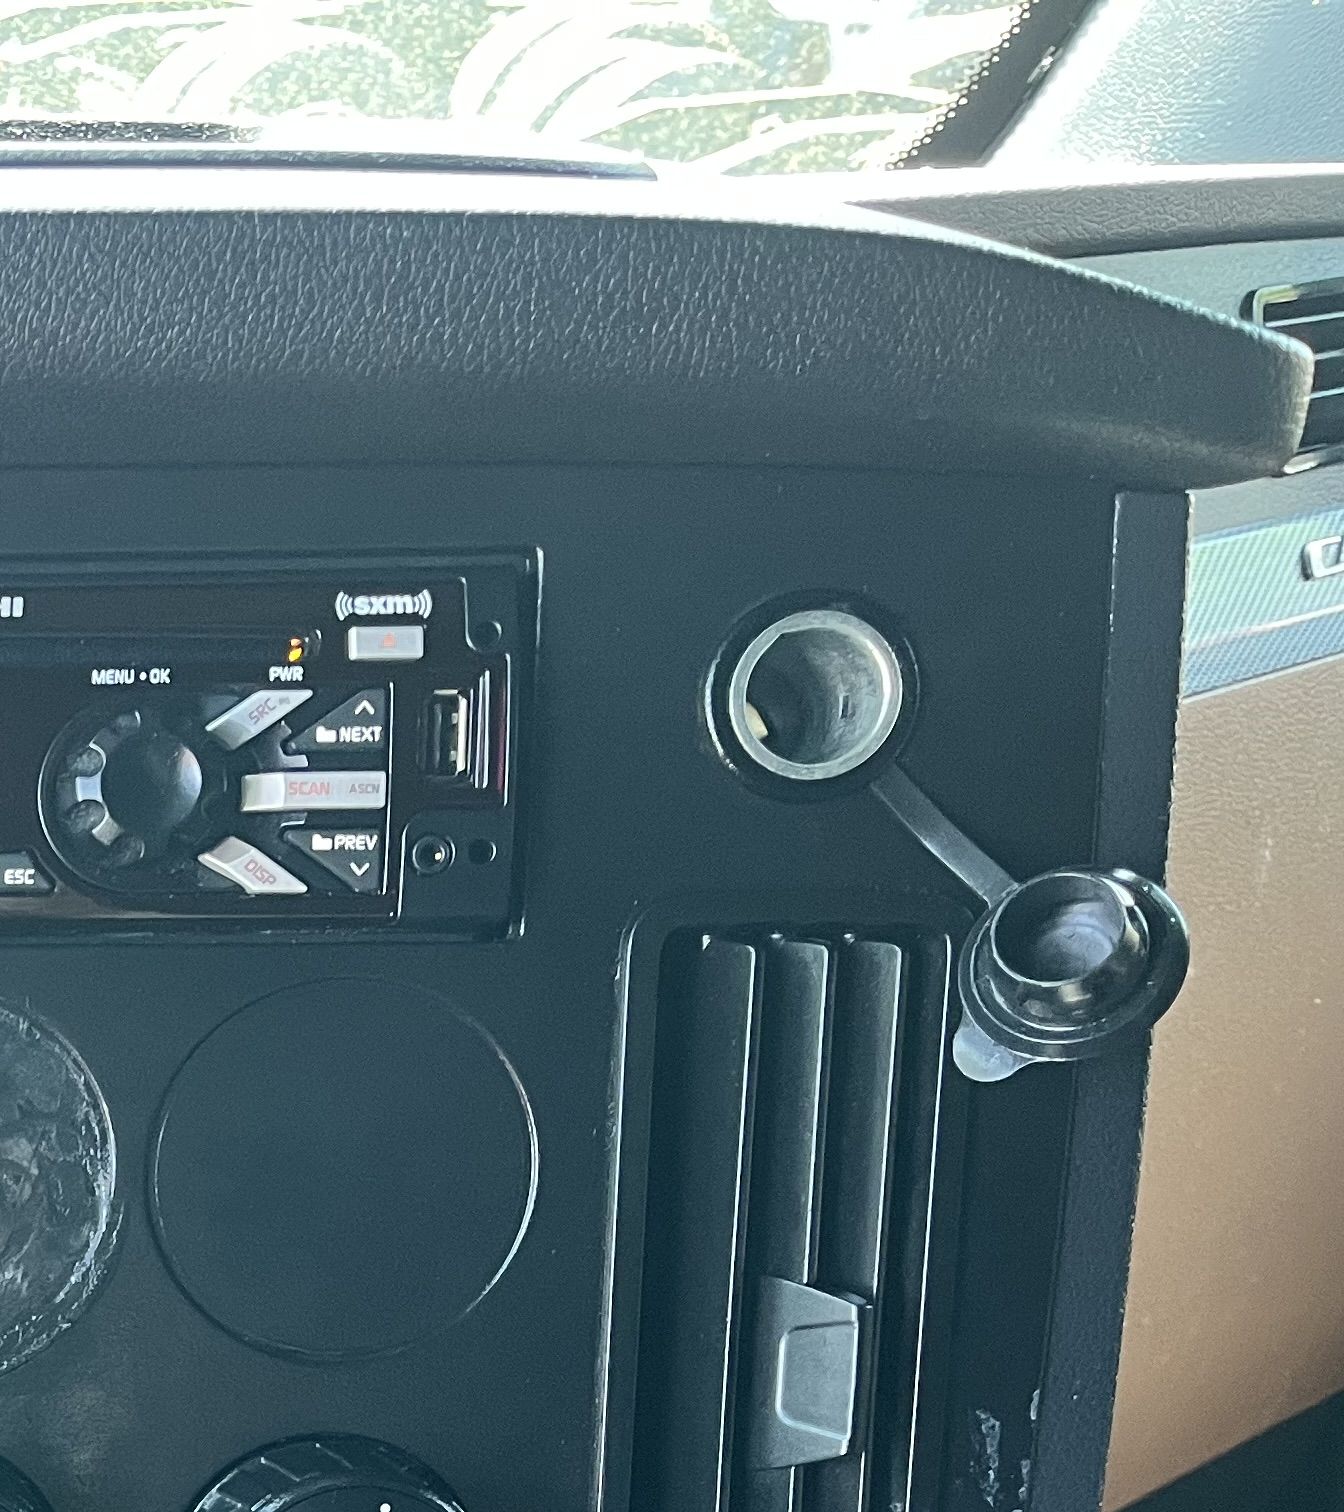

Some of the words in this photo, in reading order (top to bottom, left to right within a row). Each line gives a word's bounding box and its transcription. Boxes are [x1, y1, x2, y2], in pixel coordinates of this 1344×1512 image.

[353, 594, 415, 616] sxm
[90, 668, 134, 685] MENU
[149, 668, 171, 685] OK
[269, 666, 304, 682] PWR
[249, 698, 277, 724] SRC
[339, 726, 382, 743] NEXT
[288, 782, 331, 796] SCAN
[349, 783, 380, 794] ASCN
[334, 834, 378, 851] PREV
[4, 869, 35, 885] ESC
[244, 859, 277, 885] DISP
